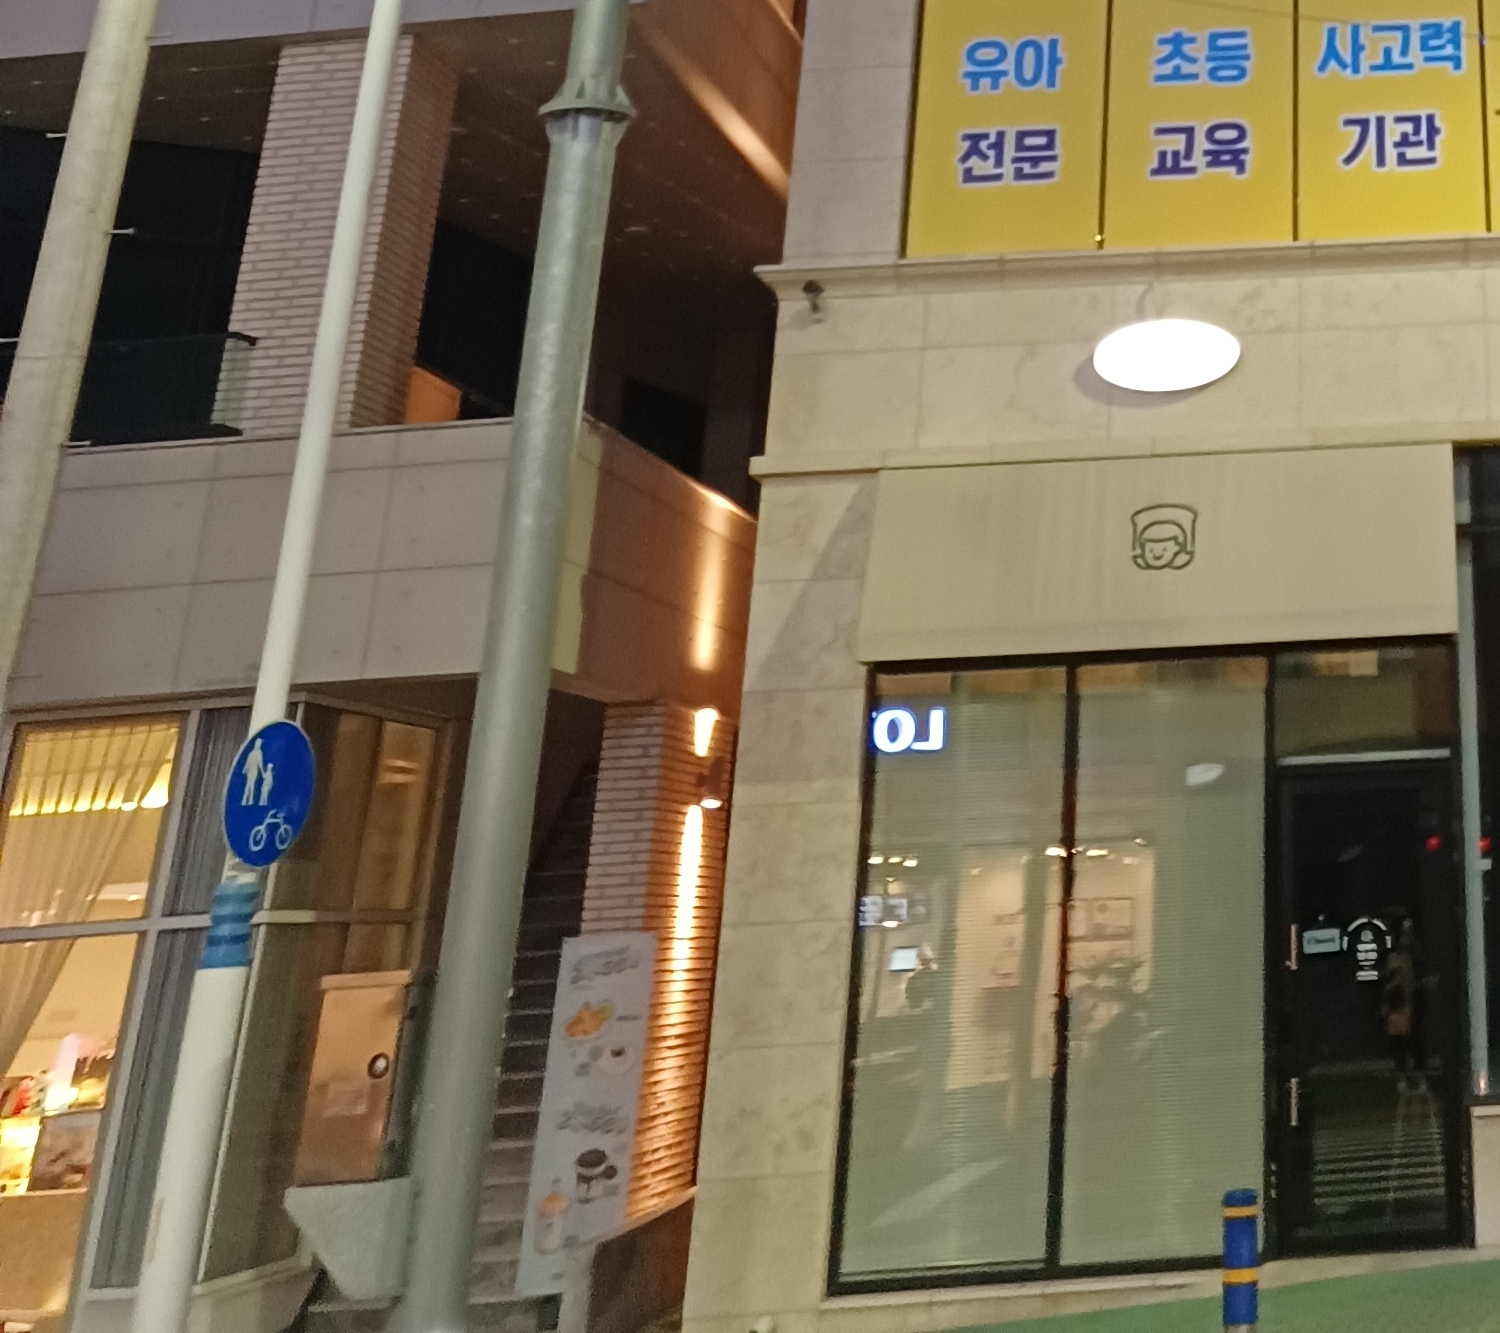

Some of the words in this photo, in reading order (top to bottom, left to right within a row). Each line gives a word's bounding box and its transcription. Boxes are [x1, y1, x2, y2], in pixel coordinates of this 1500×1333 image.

[962, 37, 1063, 92] 유아
[1152, 31, 1252, 84] 초등
[1317, 20, 1464, 75] 사고력
[958, 129, 1060, 185] 전문
[1150, 122, 1251, 176] 교육
[1341, 113, 1442, 169] 기관
